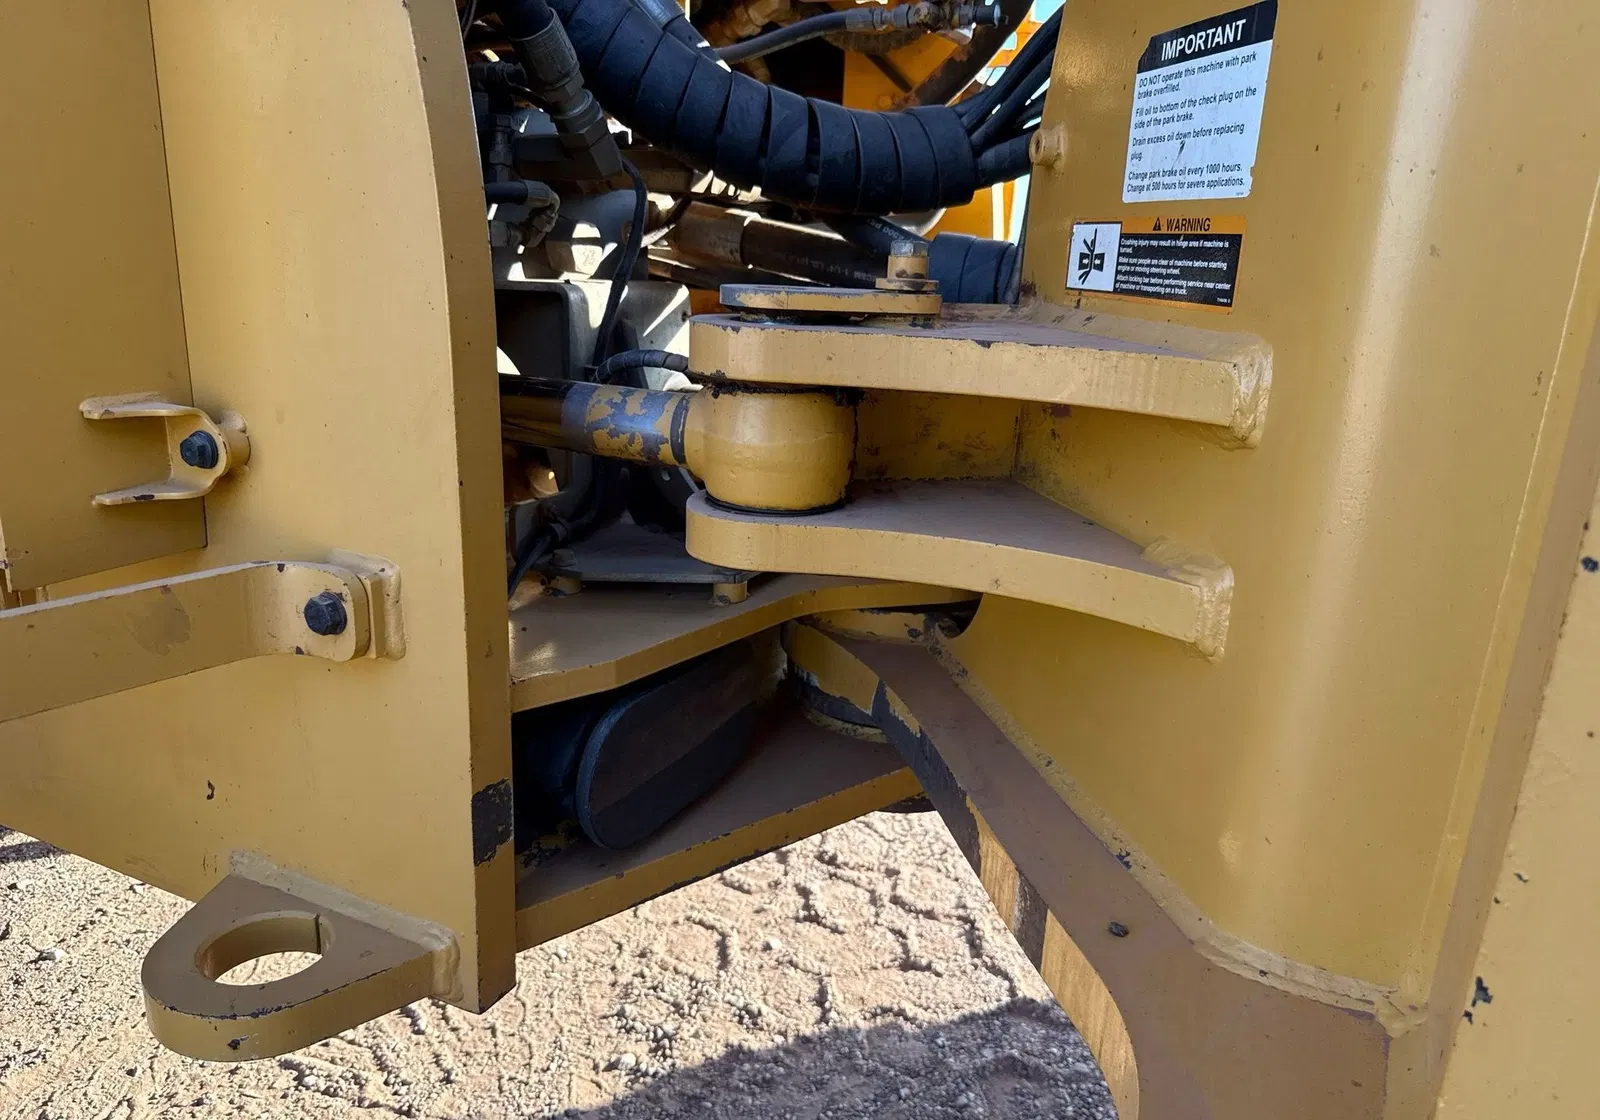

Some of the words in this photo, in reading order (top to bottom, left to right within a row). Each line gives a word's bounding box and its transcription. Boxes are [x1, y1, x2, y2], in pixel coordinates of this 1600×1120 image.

[1161, 19, 1246, 61] IMPORTANT
[1139, 78, 1147, 88] DO
[1148, 75, 1161, 85] NOT
[1162, 71, 1182, 83] operate
[1184, 68, 1195, 77] this
[1197, 61, 1223, 74] machine
[1225, 57, 1239, 67] with
[1240, 51, 1256, 66] park
[1138, 89, 1152, 99] brake
[1154, 83, 1180, 96] overfilled.
[1136, 108, 1144, 117] Fill
[1153, 105, 1158, 114] to
[1160, 100, 1179, 113] bottom
[1180, 100, 1187, 109] of
[1188, 98, 1197, 108] the
[1198, 93, 1217, 105] check
[1218, 90, 1233, 104] plug
[1235, 90, 1243, 98] on
[1245, 86, 1256, 96] the
[1134, 119, 1145, 130] side
[1146, 118, 1152, 128] of
[1153, 117, 1161, 126] the
[1162, 115, 1175, 128] park
[1176, 112, 1194, 122] brake.
[1132, 136, 1146, 146] Drain
[1147, 134, 1165, 144] excess
[1175, 130, 1191, 140] down
[1192, 127, 1212, 138] before
[1214, 122, 1244, 136] replacing
[1131, 151, 1143, 162] plug.
[1128, 171, 1147, 182] Change
[1149, 168, 1160, 179] park
[1162, 168, 1177, 178] brake
[1187, 166, 1204, 177] every
[1206, 163, 1220, 174] 1000
[1222, 162, 1242, 172] hours.
[1127, 183, 1145, 194] Change
[1146, 183, 1152, 192] at
[1152, 182, 1160, 191] 500
[1161, 181, 1176, 190] hours
[1186, 180, 1205, 188] severe
[1206, 176, 1245, 190] applications.
[1167, 218, 1210, 231] WARNING
[1121, 239, 1137, 247] Crushing
[1150, 240, 1158, 248] may
[1176, 239, 1188, 248] hinge
[1117, 265, 1130, 273] engine
[1150, 267, 1166, 275] steering
[1209, 261, 1227, 270] starting
[1120, 282, 1135, 290] machine
[1141, 284, 1164, 294] transporting
[1175, 287, 1187, 295] truck.
[1164, 279, 1186, 287] performing
